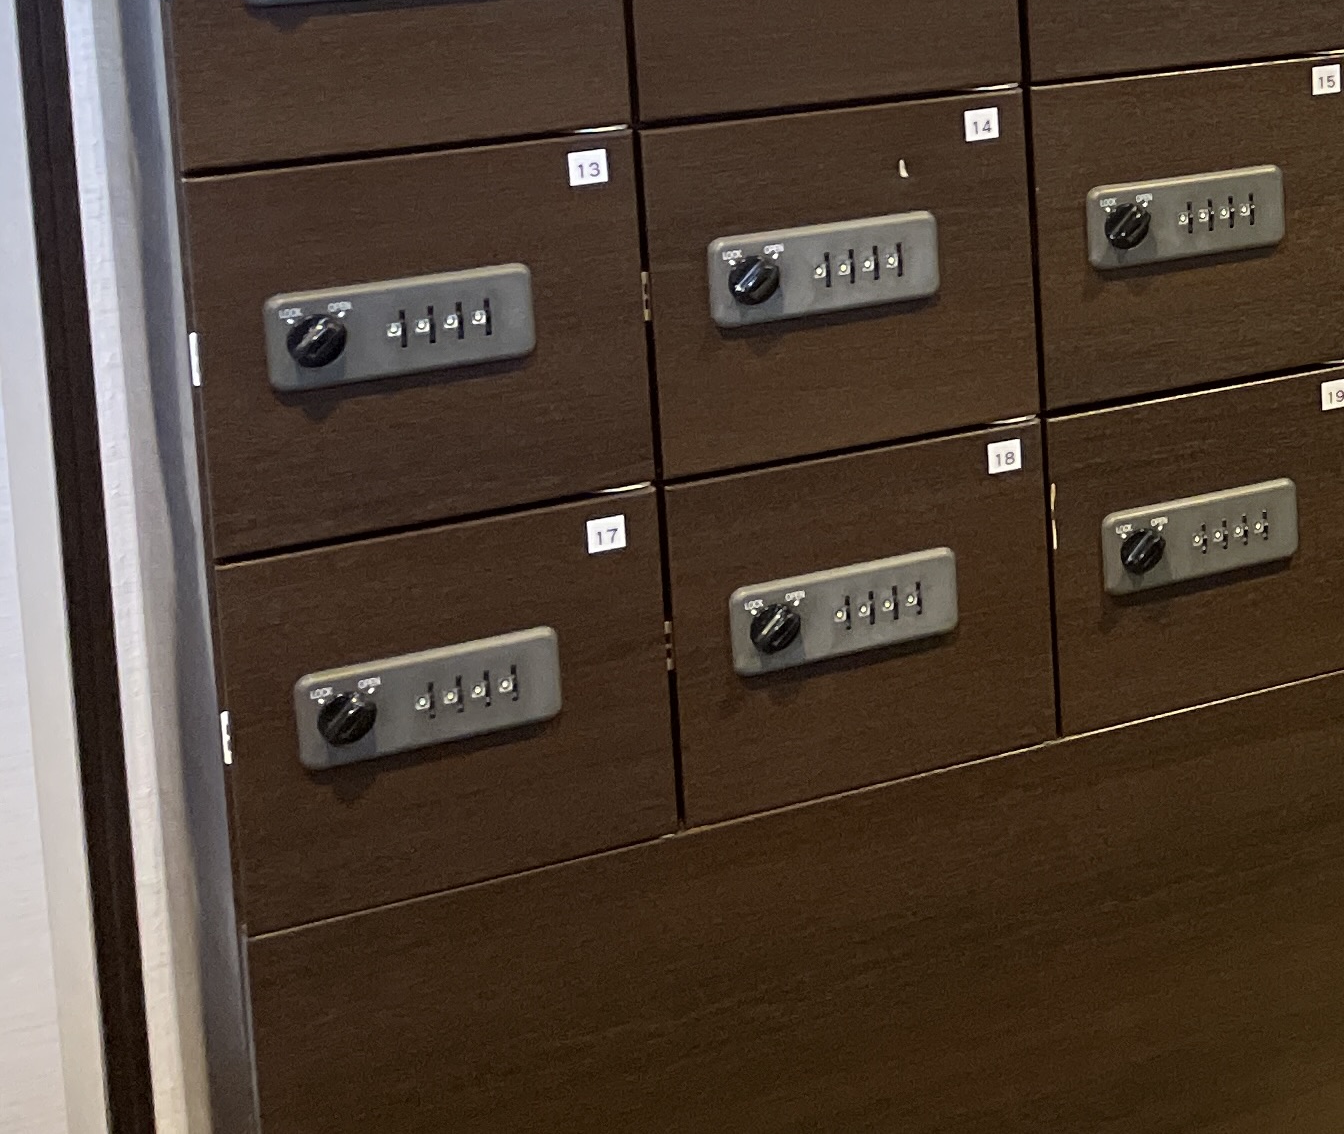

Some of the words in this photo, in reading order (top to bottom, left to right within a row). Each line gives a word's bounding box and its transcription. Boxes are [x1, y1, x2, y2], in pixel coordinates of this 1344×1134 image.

[1318, 75, 1335, 89] 15
[973, 120, 992, 135] 14
[578, 162, 600, 178] 13
[1328, 389, 1344, 404] 19
[995, 451, 1015, 466] 18
[597, 528, 618, 545] 17
